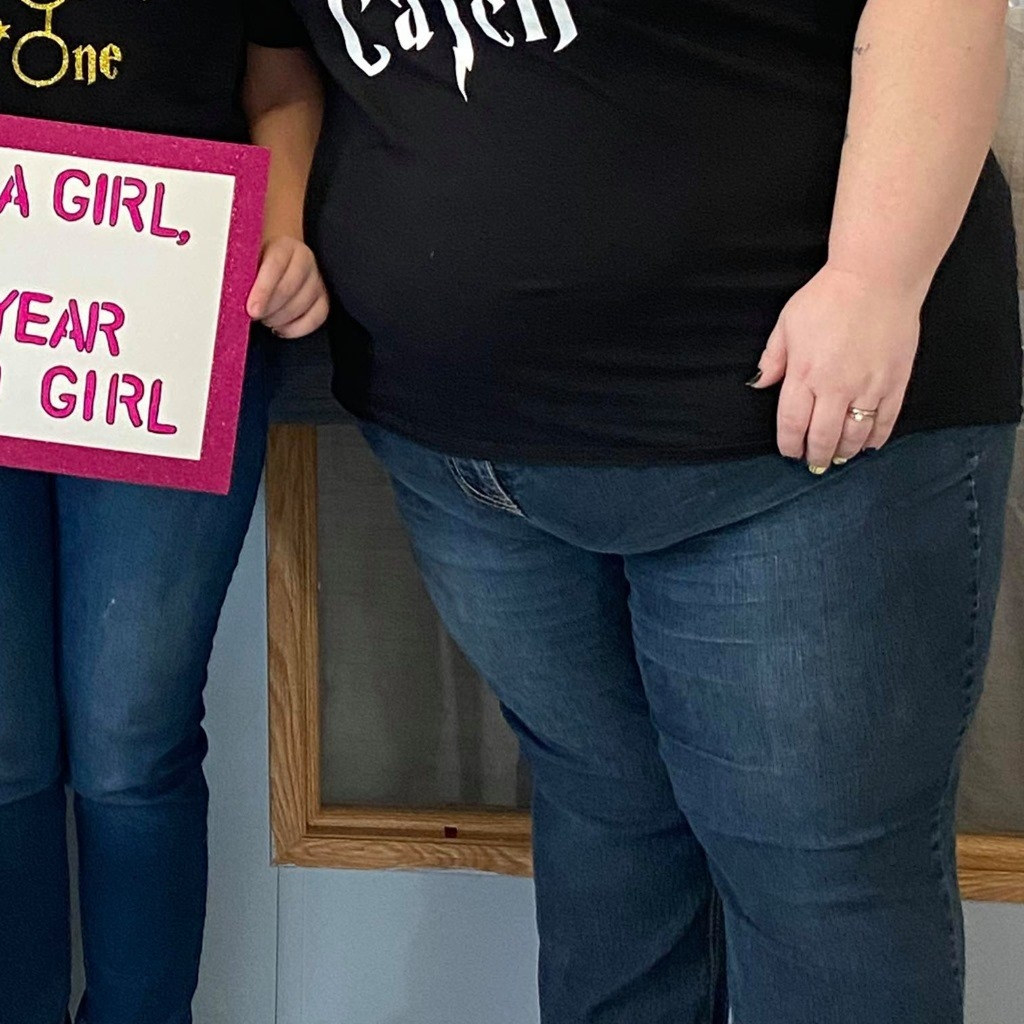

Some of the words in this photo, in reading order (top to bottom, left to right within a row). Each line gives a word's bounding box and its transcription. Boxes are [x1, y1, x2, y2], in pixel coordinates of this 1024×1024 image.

[11, 29, 123, 88] One
[52, 167, 192, 247] GIRL,
[40, 364, 178, 436] GIRL
